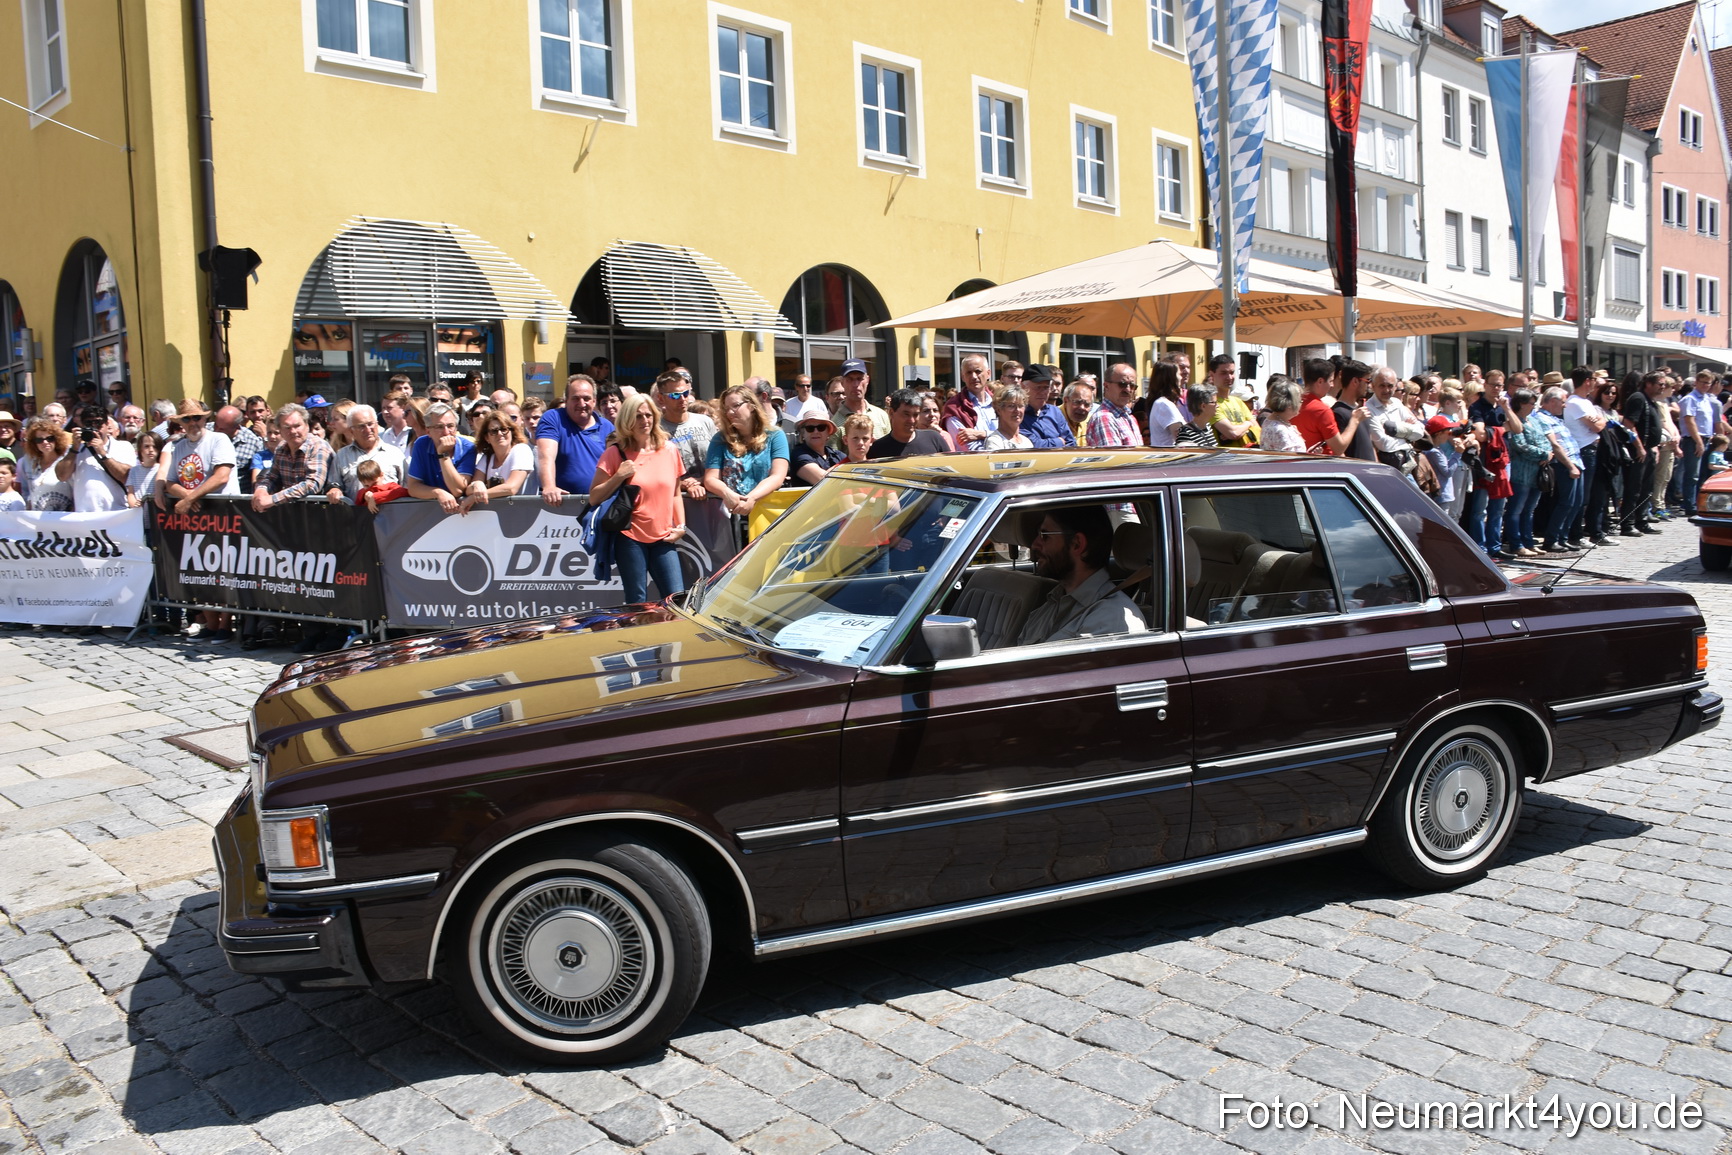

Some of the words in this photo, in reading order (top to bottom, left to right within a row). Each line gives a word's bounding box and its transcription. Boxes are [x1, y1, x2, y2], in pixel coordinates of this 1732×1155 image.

[949, 499, 968, 508] ADAC
[157, 513, 243, 534] FAHRSCHULE
[536, 525, 581, 539] Auto
[0, 529, 123, 560] taktuell
[180, 533, 336, 585] Kohlmann
[335, 571, 368, 586] GmbH
[0, 569, 24, 580] RTAL
[27, 568, 46, 579] FÜR
[179, 572, 216, 585] Neumarkt
[219, 577, 257, 590] Burgthann
[261, 579, 296, 594] Freystadt
[300, 583, 335, 599] Pyrbaum
[499, 583, 575, 591] BREITENBRUNN
[841, 618, 875, 628] 604
